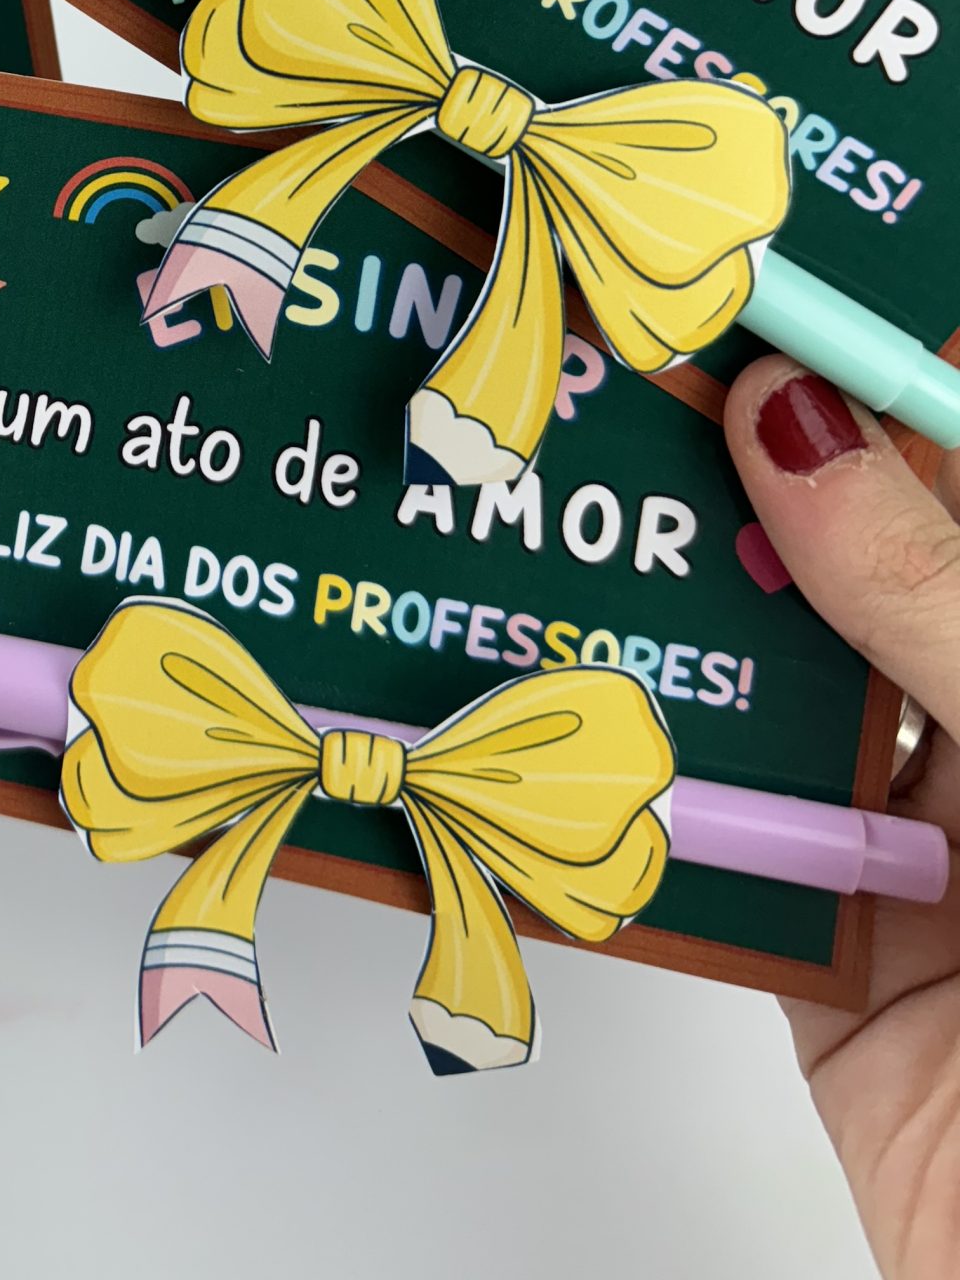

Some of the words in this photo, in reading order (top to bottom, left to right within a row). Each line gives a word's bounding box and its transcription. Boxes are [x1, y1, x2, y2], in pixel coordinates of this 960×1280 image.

[121, 394, 242, 483] ato
[274, 418, 360, 508] de
[397, 472, 697, 577] AMOR
[81, 523, 165, 591] DIA
[184, 547, 298, 617] DOS
[313, 573, 755, 711] PROFESSORES!
